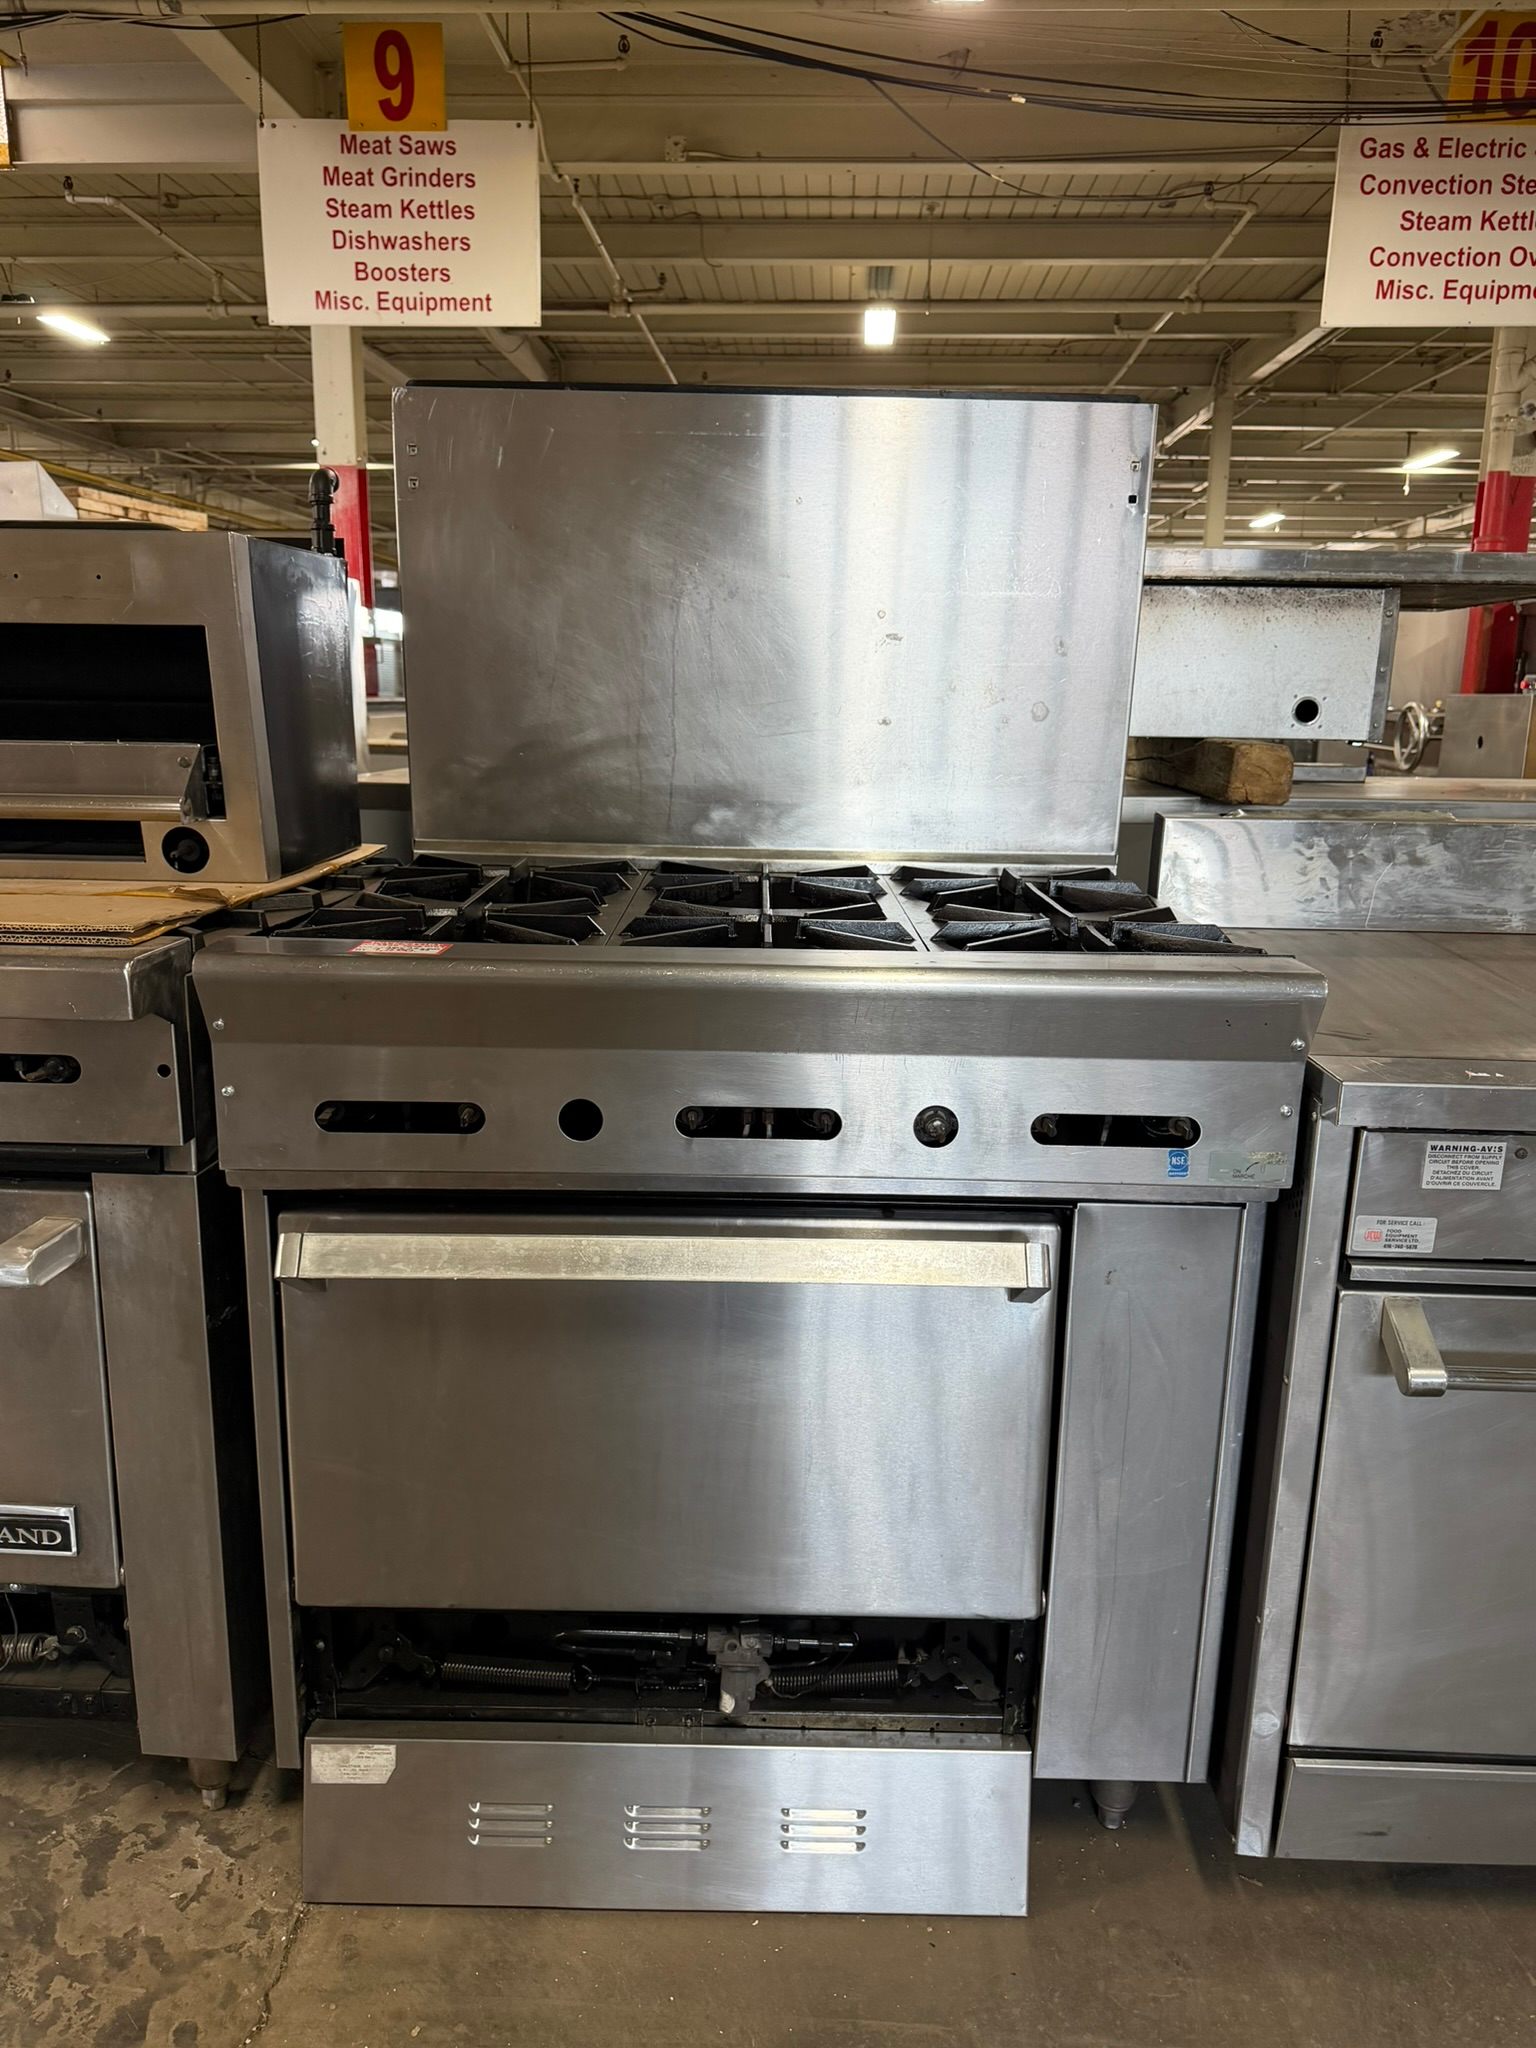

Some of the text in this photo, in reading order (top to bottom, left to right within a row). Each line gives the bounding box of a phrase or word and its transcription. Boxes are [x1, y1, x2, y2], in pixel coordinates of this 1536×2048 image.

[374, 30, 415, 122] 9
[1463, 20, 1536, 117] 10
[340, 134, 457, 156] Meat Saws
[1360, 137, 1527, 159] Gas & Electric
[323, 166, 476, 188] Meat Grinders
[1360, 174, 1493, 195] Convection
[326, 198, 475, 220] Steam Kettles
[1400, 210, 1536, 231] Steam Kettl
[332, 230, 471, 251] Dishwashers
[1369, 246, 1501, 267] Convection
[354, 262, 451, 282] Boosters
[315, 290, 492, 316] Misc. Equipment
[1375, 279, 1536, 305] Misc. Equipm
